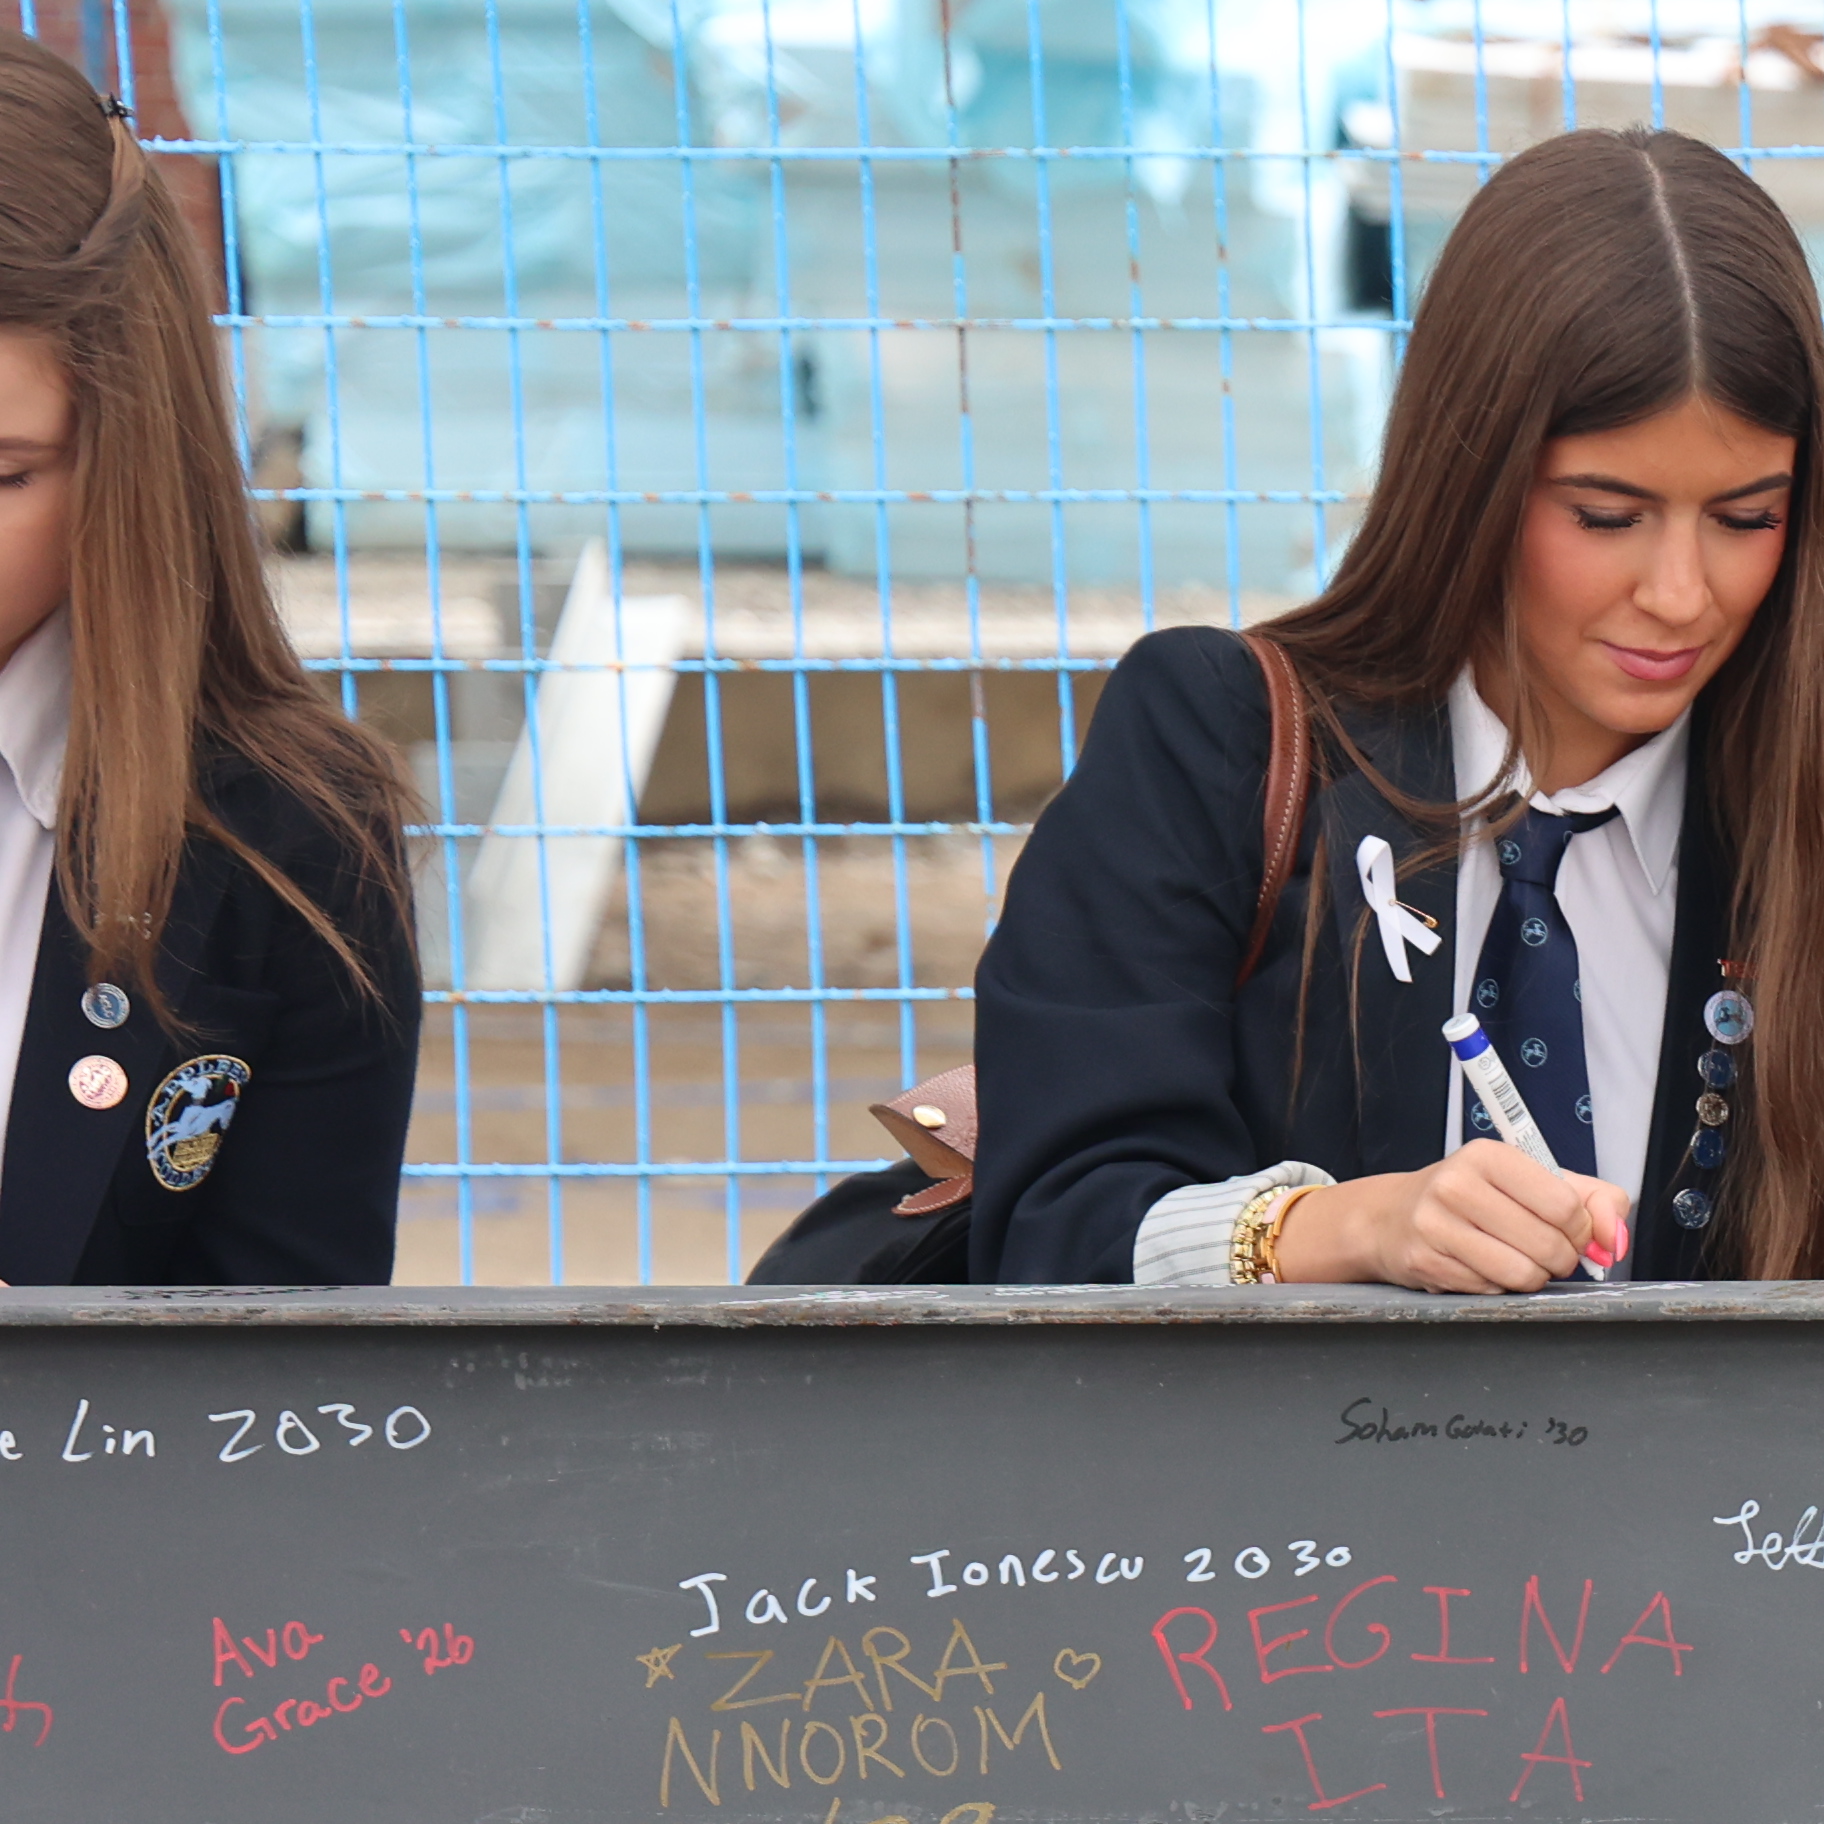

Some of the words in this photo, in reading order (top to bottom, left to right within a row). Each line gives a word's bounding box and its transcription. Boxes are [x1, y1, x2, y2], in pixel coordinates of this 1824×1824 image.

[62, 1399, 155, 1462] Lin
[208, 1403, 431, 1462] 2030
[679, 1569, 880, 1640] Jack
[1184, 1540, 1351, 1582] 2030
[213, 1617, 324, 1686] Ava
[700, 1616, 1010, 1714] ZARA
[1150, 1572, 1694, 1712] REGINA
[1261, 1697, 1593, 1812] ITA
